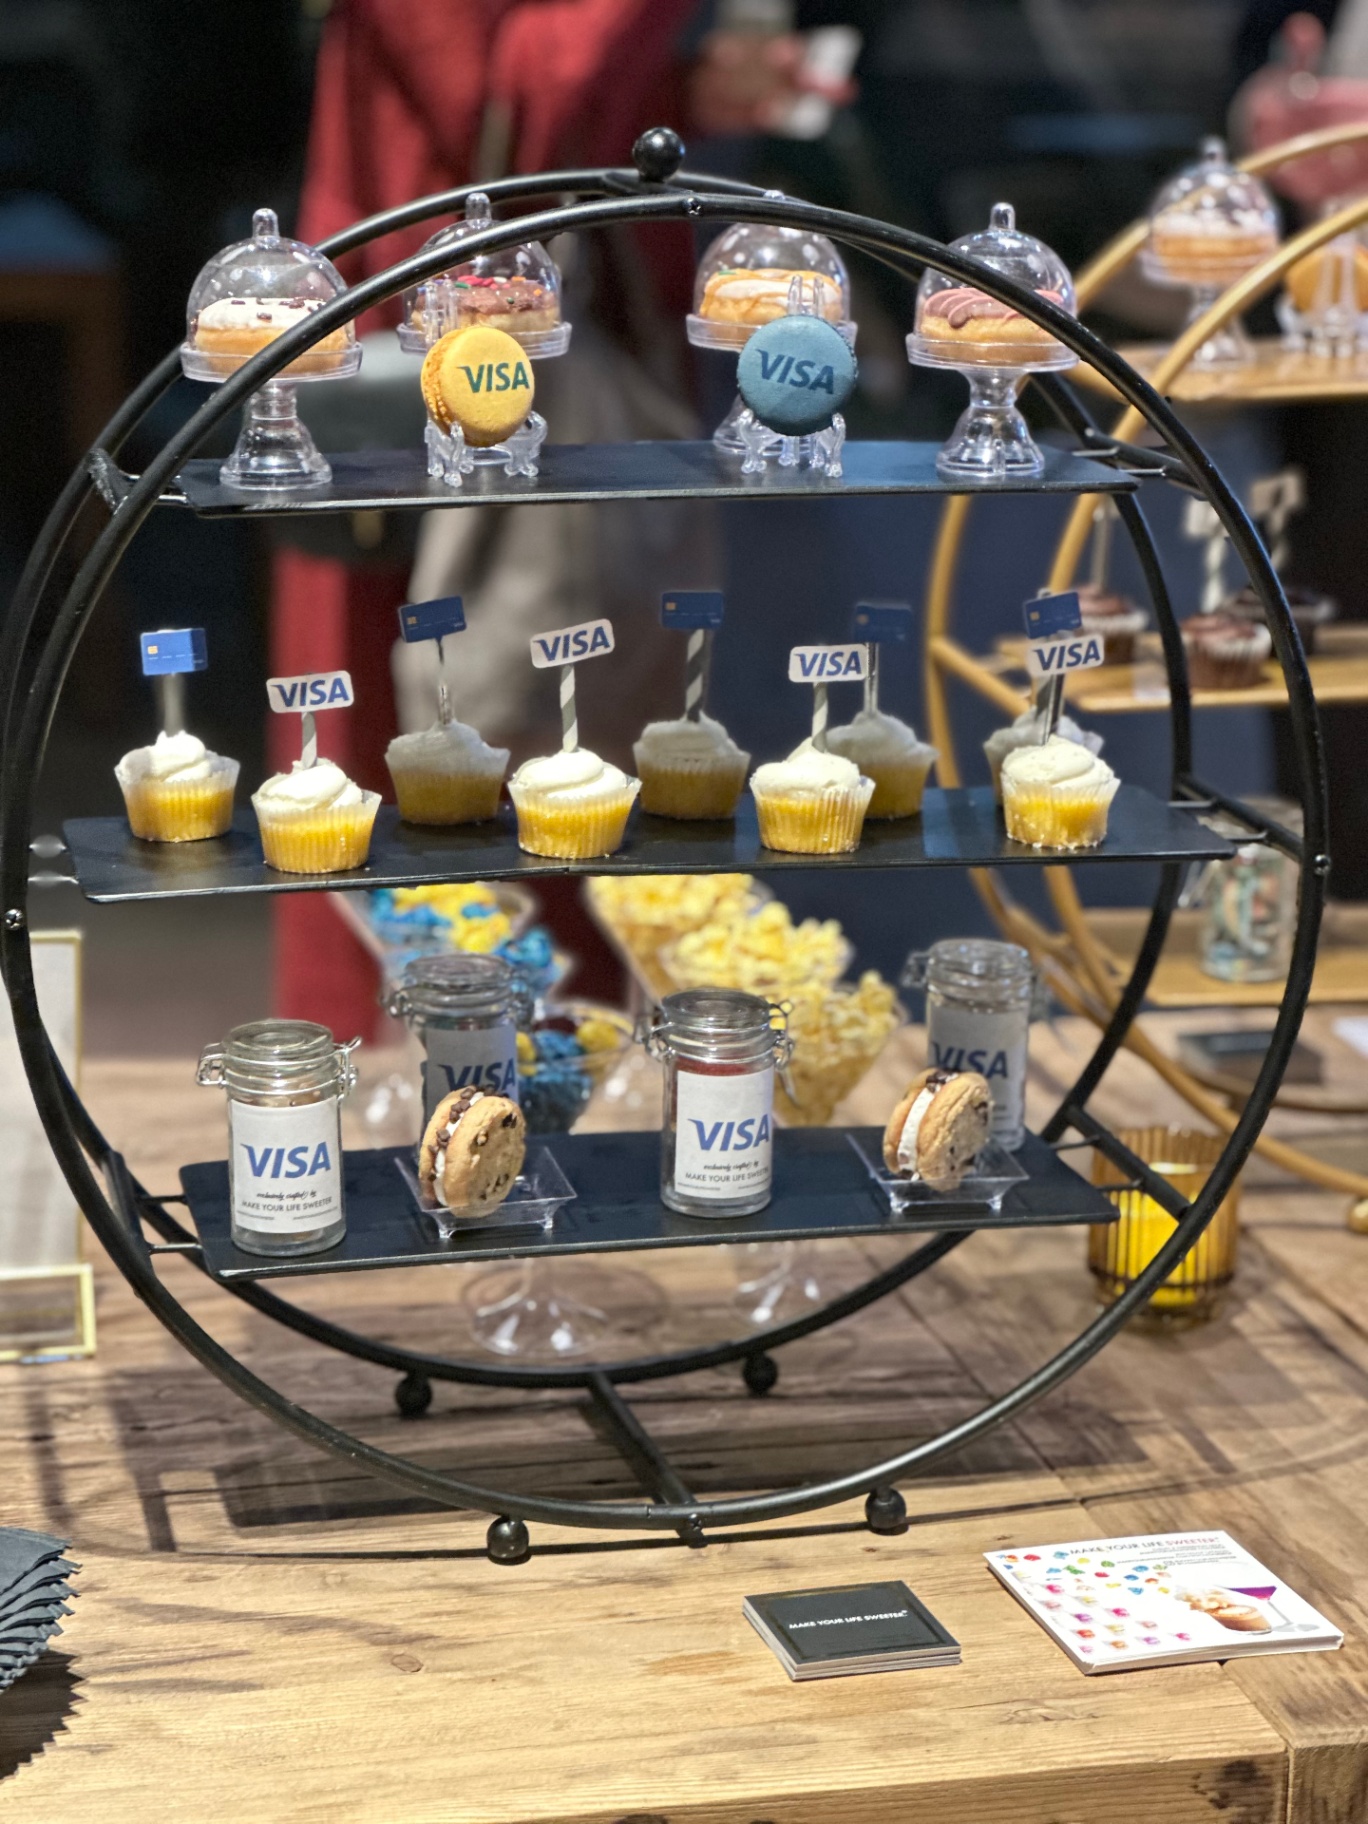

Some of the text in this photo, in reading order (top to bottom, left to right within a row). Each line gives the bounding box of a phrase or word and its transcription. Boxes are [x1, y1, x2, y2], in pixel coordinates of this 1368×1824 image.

[457, 362, 530, 393] VISA
[756, 349, 834, 394] VISA
[533, 626, 611, 663] VISA
[1032, 639, 1101, 671] VISA
[793, 651, 862, 677] VISA
[271, 676, 350, 708] VISA
[438, 1057, 516, 1092] VISA
[932, 1041, 1008, 1079] VISA
[687, 1113, 769, 1152] VISA
[240, 1141, 331, 1179] VISA
[685, 1172, 706, 1182] MAKE
[708, 1175, 731, 1183] YOUR
[732, 1173, 745, 1182] LIFE
[241, 1195, 332, 1212] MAKE YOUR LIFE SWEETER
[789, 1621, 816, 1629] MAKE
[817, 1618, 844, 1626] YOUR
